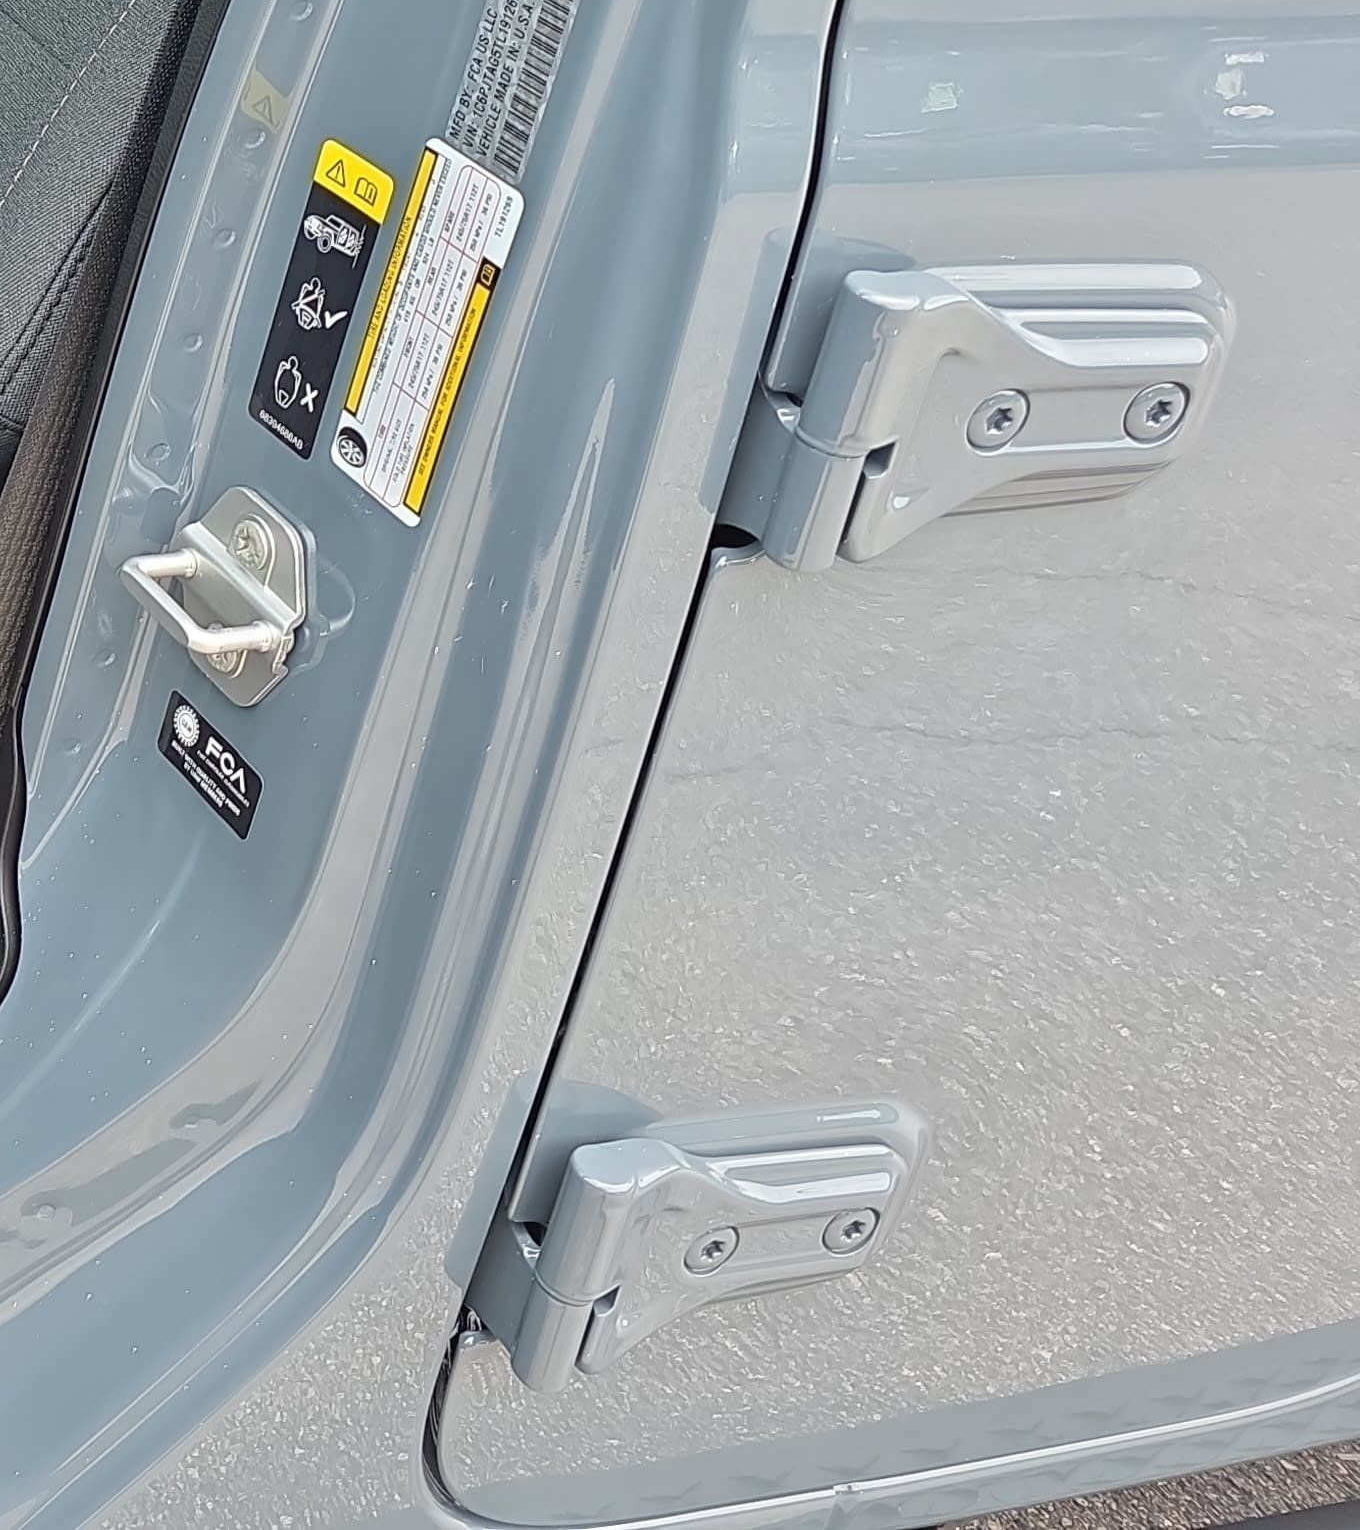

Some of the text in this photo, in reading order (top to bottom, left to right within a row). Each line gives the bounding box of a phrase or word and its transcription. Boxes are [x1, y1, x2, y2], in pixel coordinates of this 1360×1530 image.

[449, 8, 497, 140] MFD BY: FCA US LLC
[476, 2, 534, 156] VEHICLE MADE IN: U.S.A.
[462, 121, 479, 147] VIN:
[494, 196, 513, 237] TL191269
[367, 320, 378, 339] TIRE
[373, 303, 383, 321] AND
[378, 269, 394, 303] LOADING
[390, 216, 411, 268] INFORMATION
[196, 766, 216, 789] QUALITY
[205, 737, 245, 792] FCA
